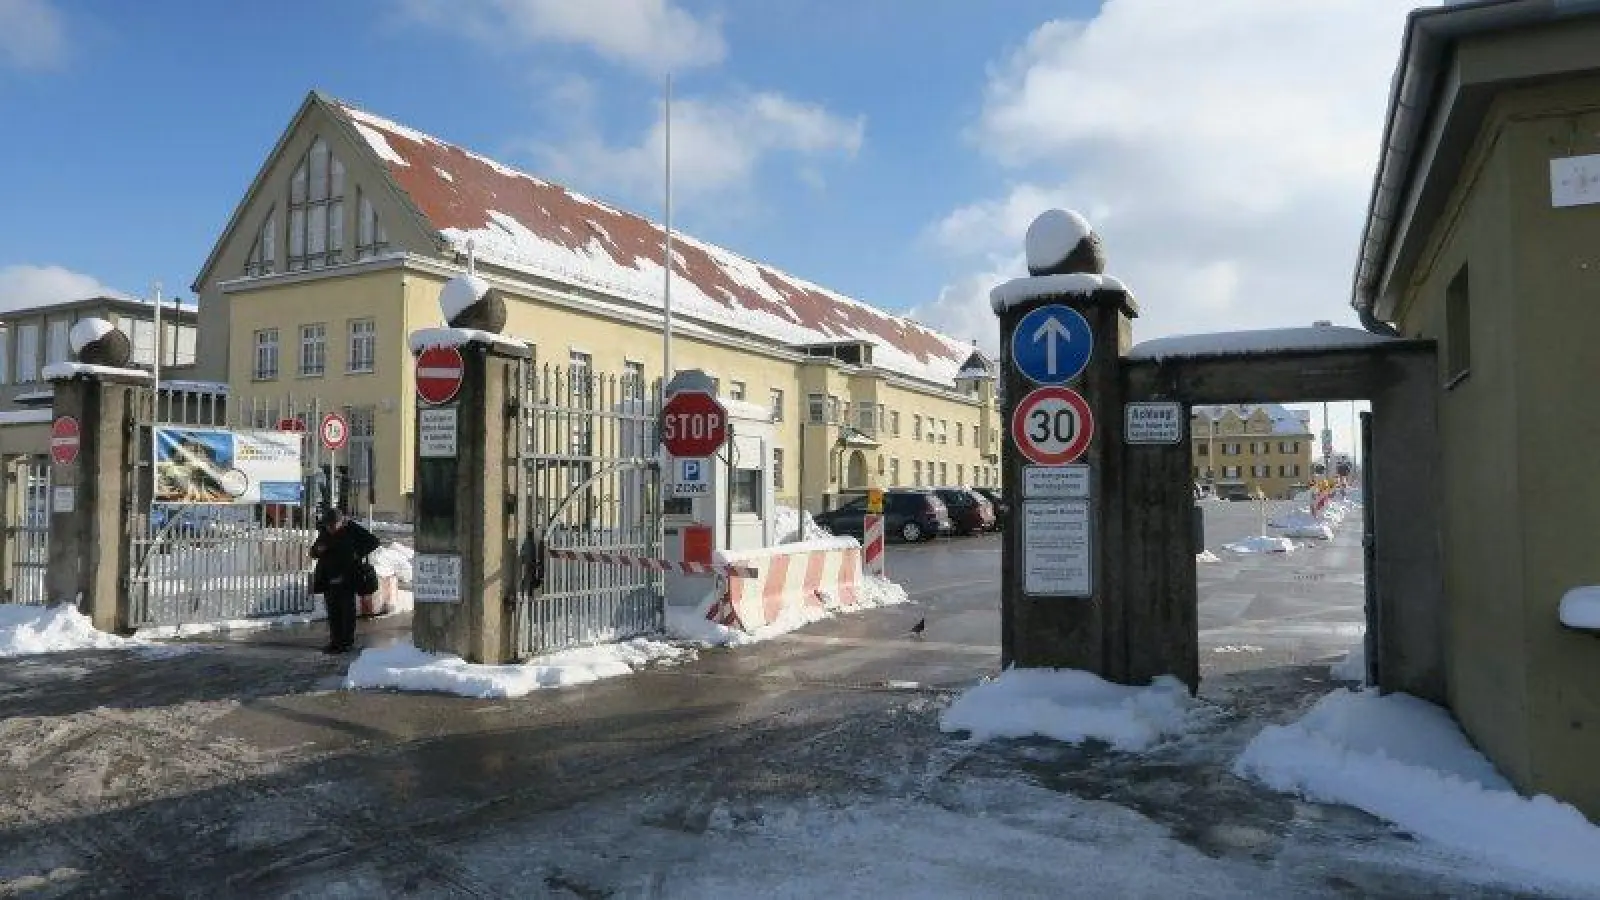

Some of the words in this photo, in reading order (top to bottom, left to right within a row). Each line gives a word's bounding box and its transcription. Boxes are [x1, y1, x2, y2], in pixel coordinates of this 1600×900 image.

[665, 413, 719, 440] STOP
[1030, 409, 1075, 442] 30
[675, 483, 708, 492] ZONE
